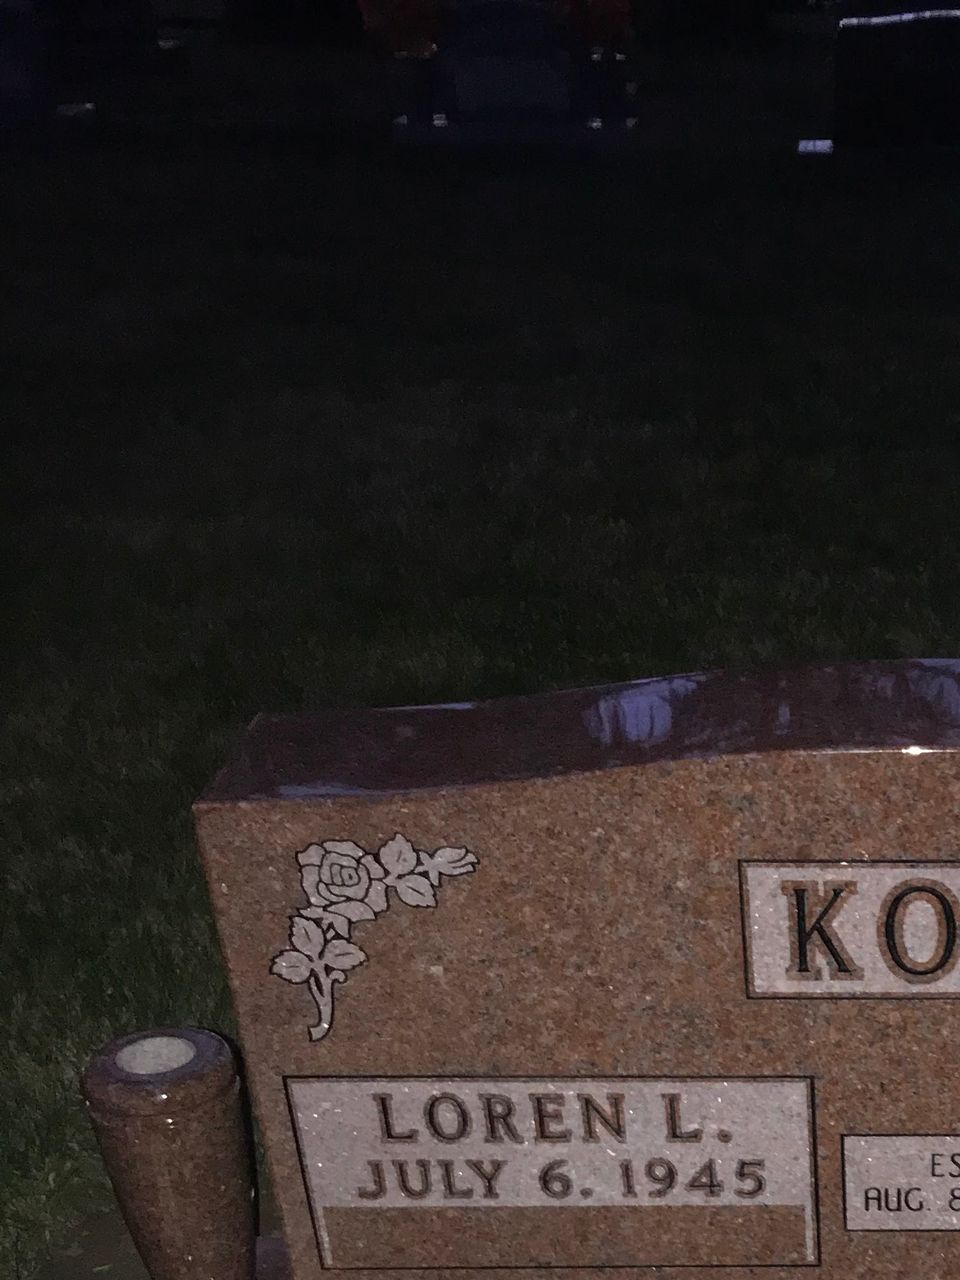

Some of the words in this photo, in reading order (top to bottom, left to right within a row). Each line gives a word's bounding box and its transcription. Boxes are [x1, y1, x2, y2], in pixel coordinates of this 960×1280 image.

[372, 1091, 627, 1145] LOREN
[661, 1092, 734, 1144] L.
[357, 1158, 507, 1200] JULY
[619, 1157, 767, 1199] 1945
[864, 1186, 932, 1212] AUG.
